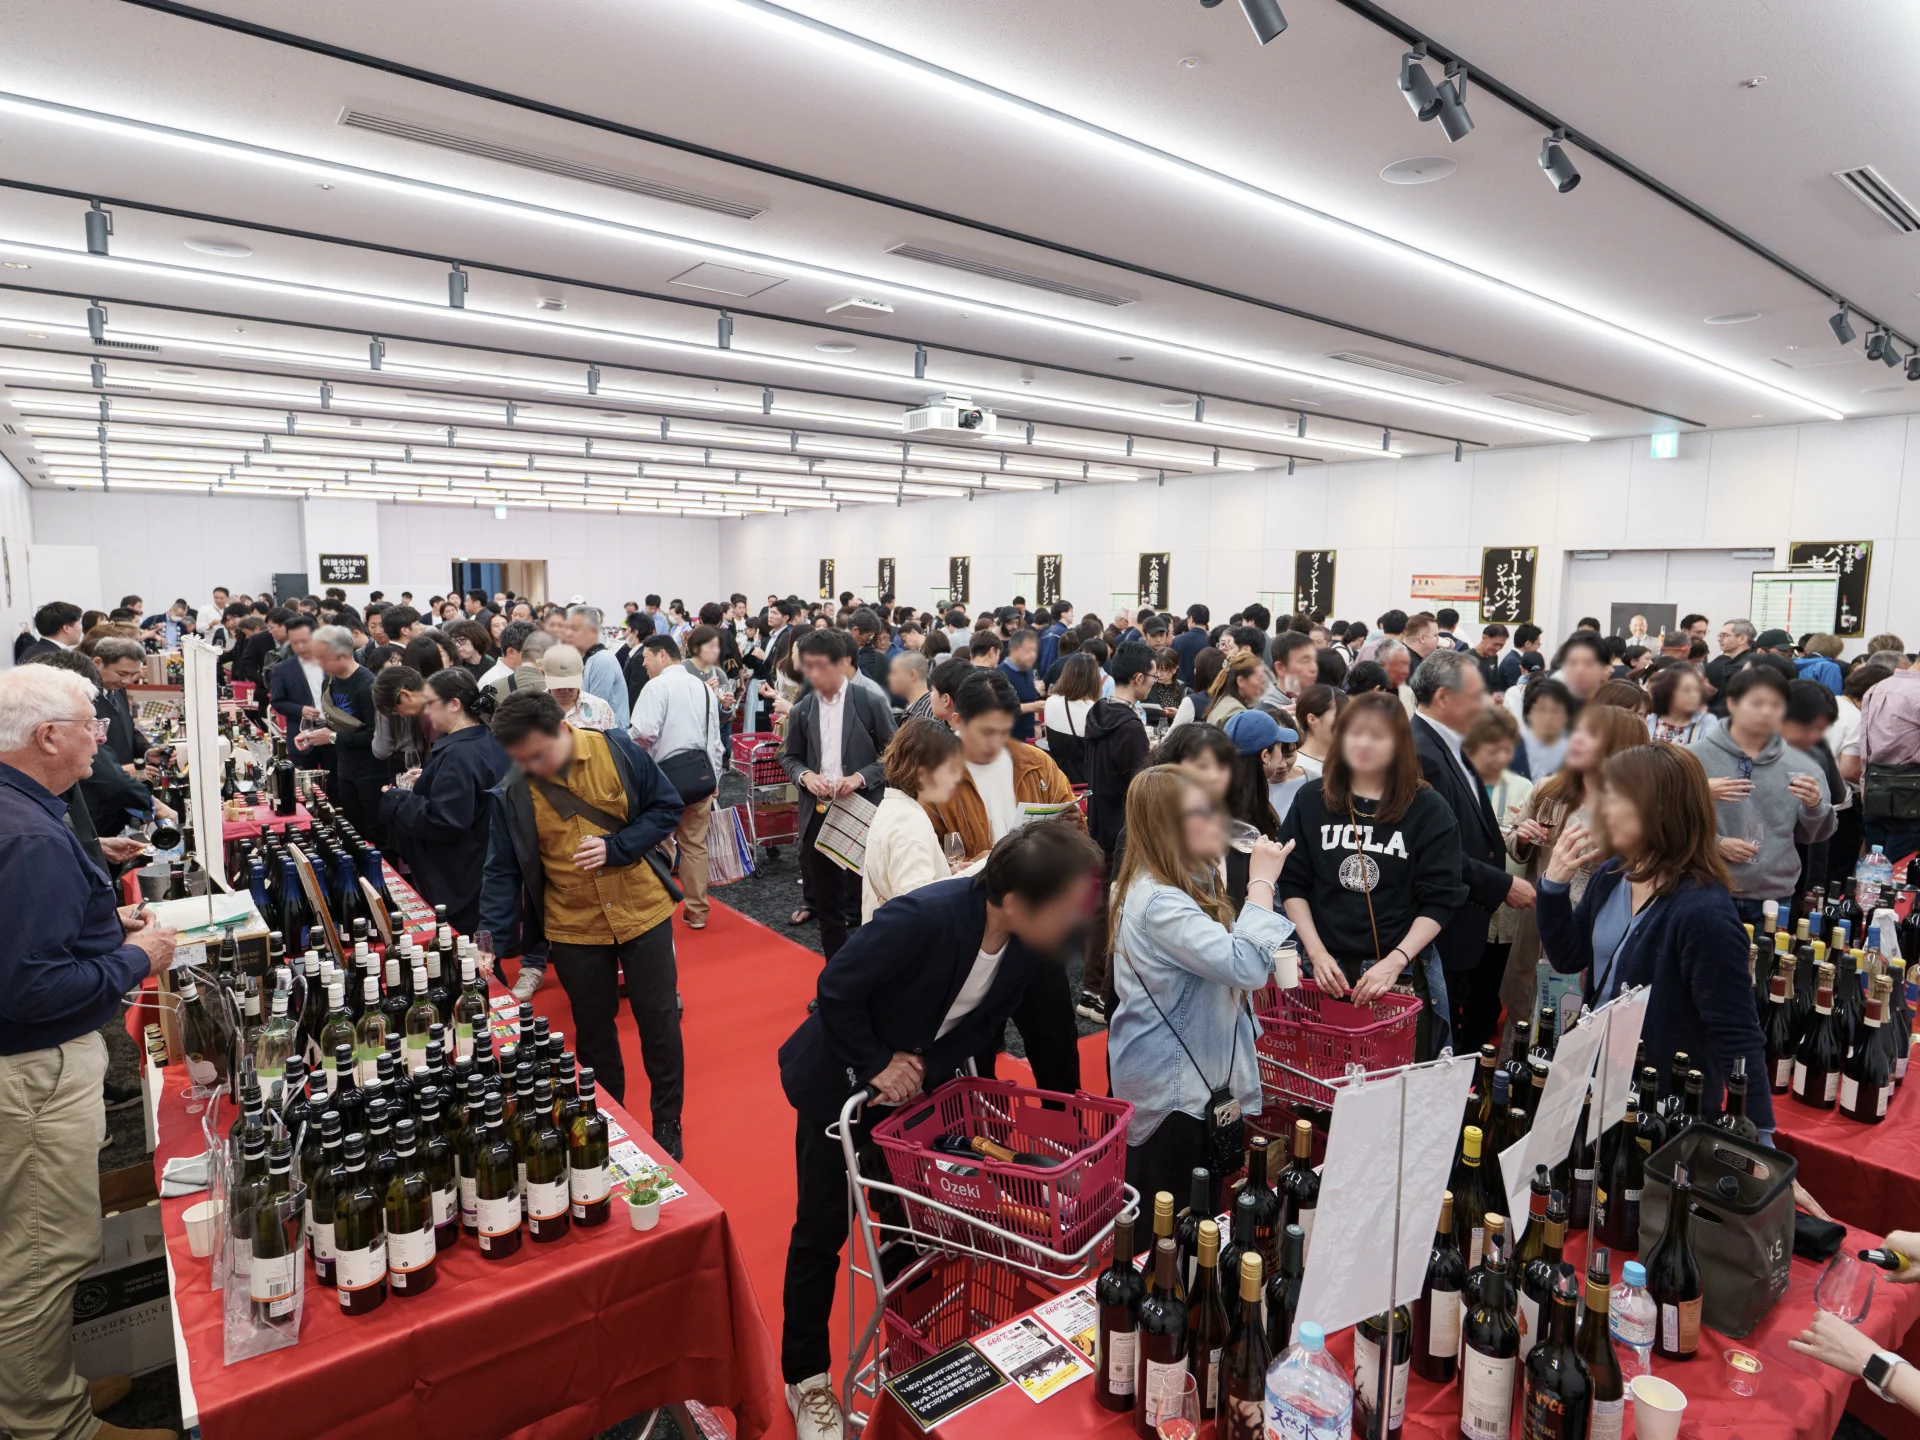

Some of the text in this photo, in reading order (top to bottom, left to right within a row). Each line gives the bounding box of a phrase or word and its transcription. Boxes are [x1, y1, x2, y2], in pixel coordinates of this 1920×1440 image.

[328, 572, 361, 580] カウンター
[1149, 557, 1159, 606] 大栄産業
[1494, 563, 1508, 607] ジャパン
[1506, 550, 1522, 621] ローヤルオブ
[1321, 824, 1408, 859] UCLA
[1263, 1035, 1297, 1052] Ozeki
[940, 1177, 981, 1199] Ozeki
[1044, 1300, 1064, 1315] 2,999
[72, 1303, 169, 1342] TAMBURLAINE
[84, 1315, 157, 1343] ORGANIC WINES
[986, 1331, 1008, 1347] 2,999
[1277, 1398, 1311, 1421] SUNTORY
[1535, 1391, 1566, 1415] VICE
